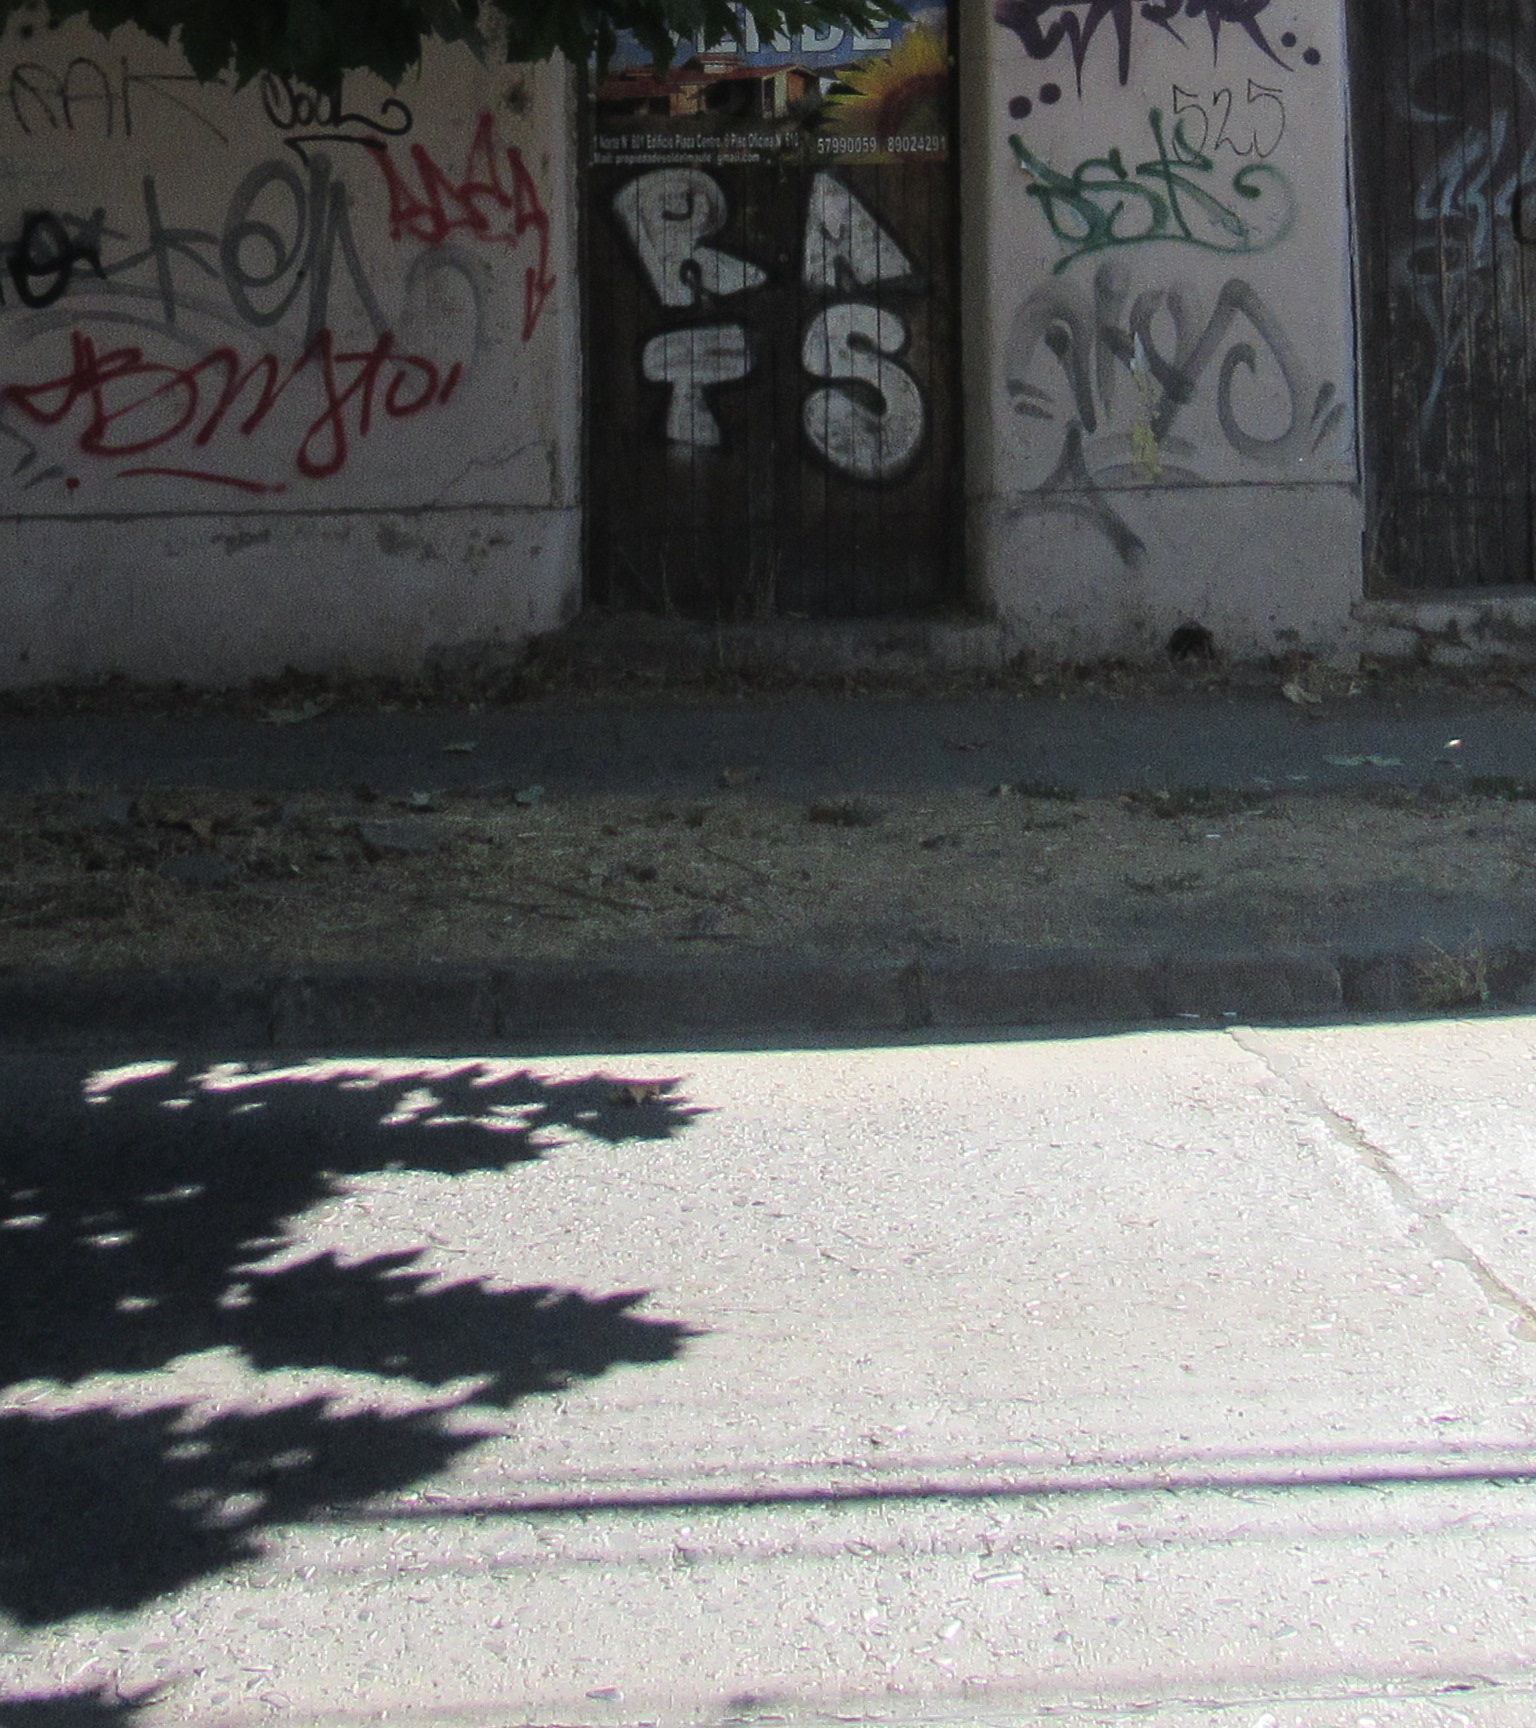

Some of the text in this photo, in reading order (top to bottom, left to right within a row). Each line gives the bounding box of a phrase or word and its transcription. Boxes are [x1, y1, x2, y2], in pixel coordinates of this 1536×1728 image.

[1171, 78, 1286, 159] 525
[817, 135, 947, 154] 57990059 89024291
